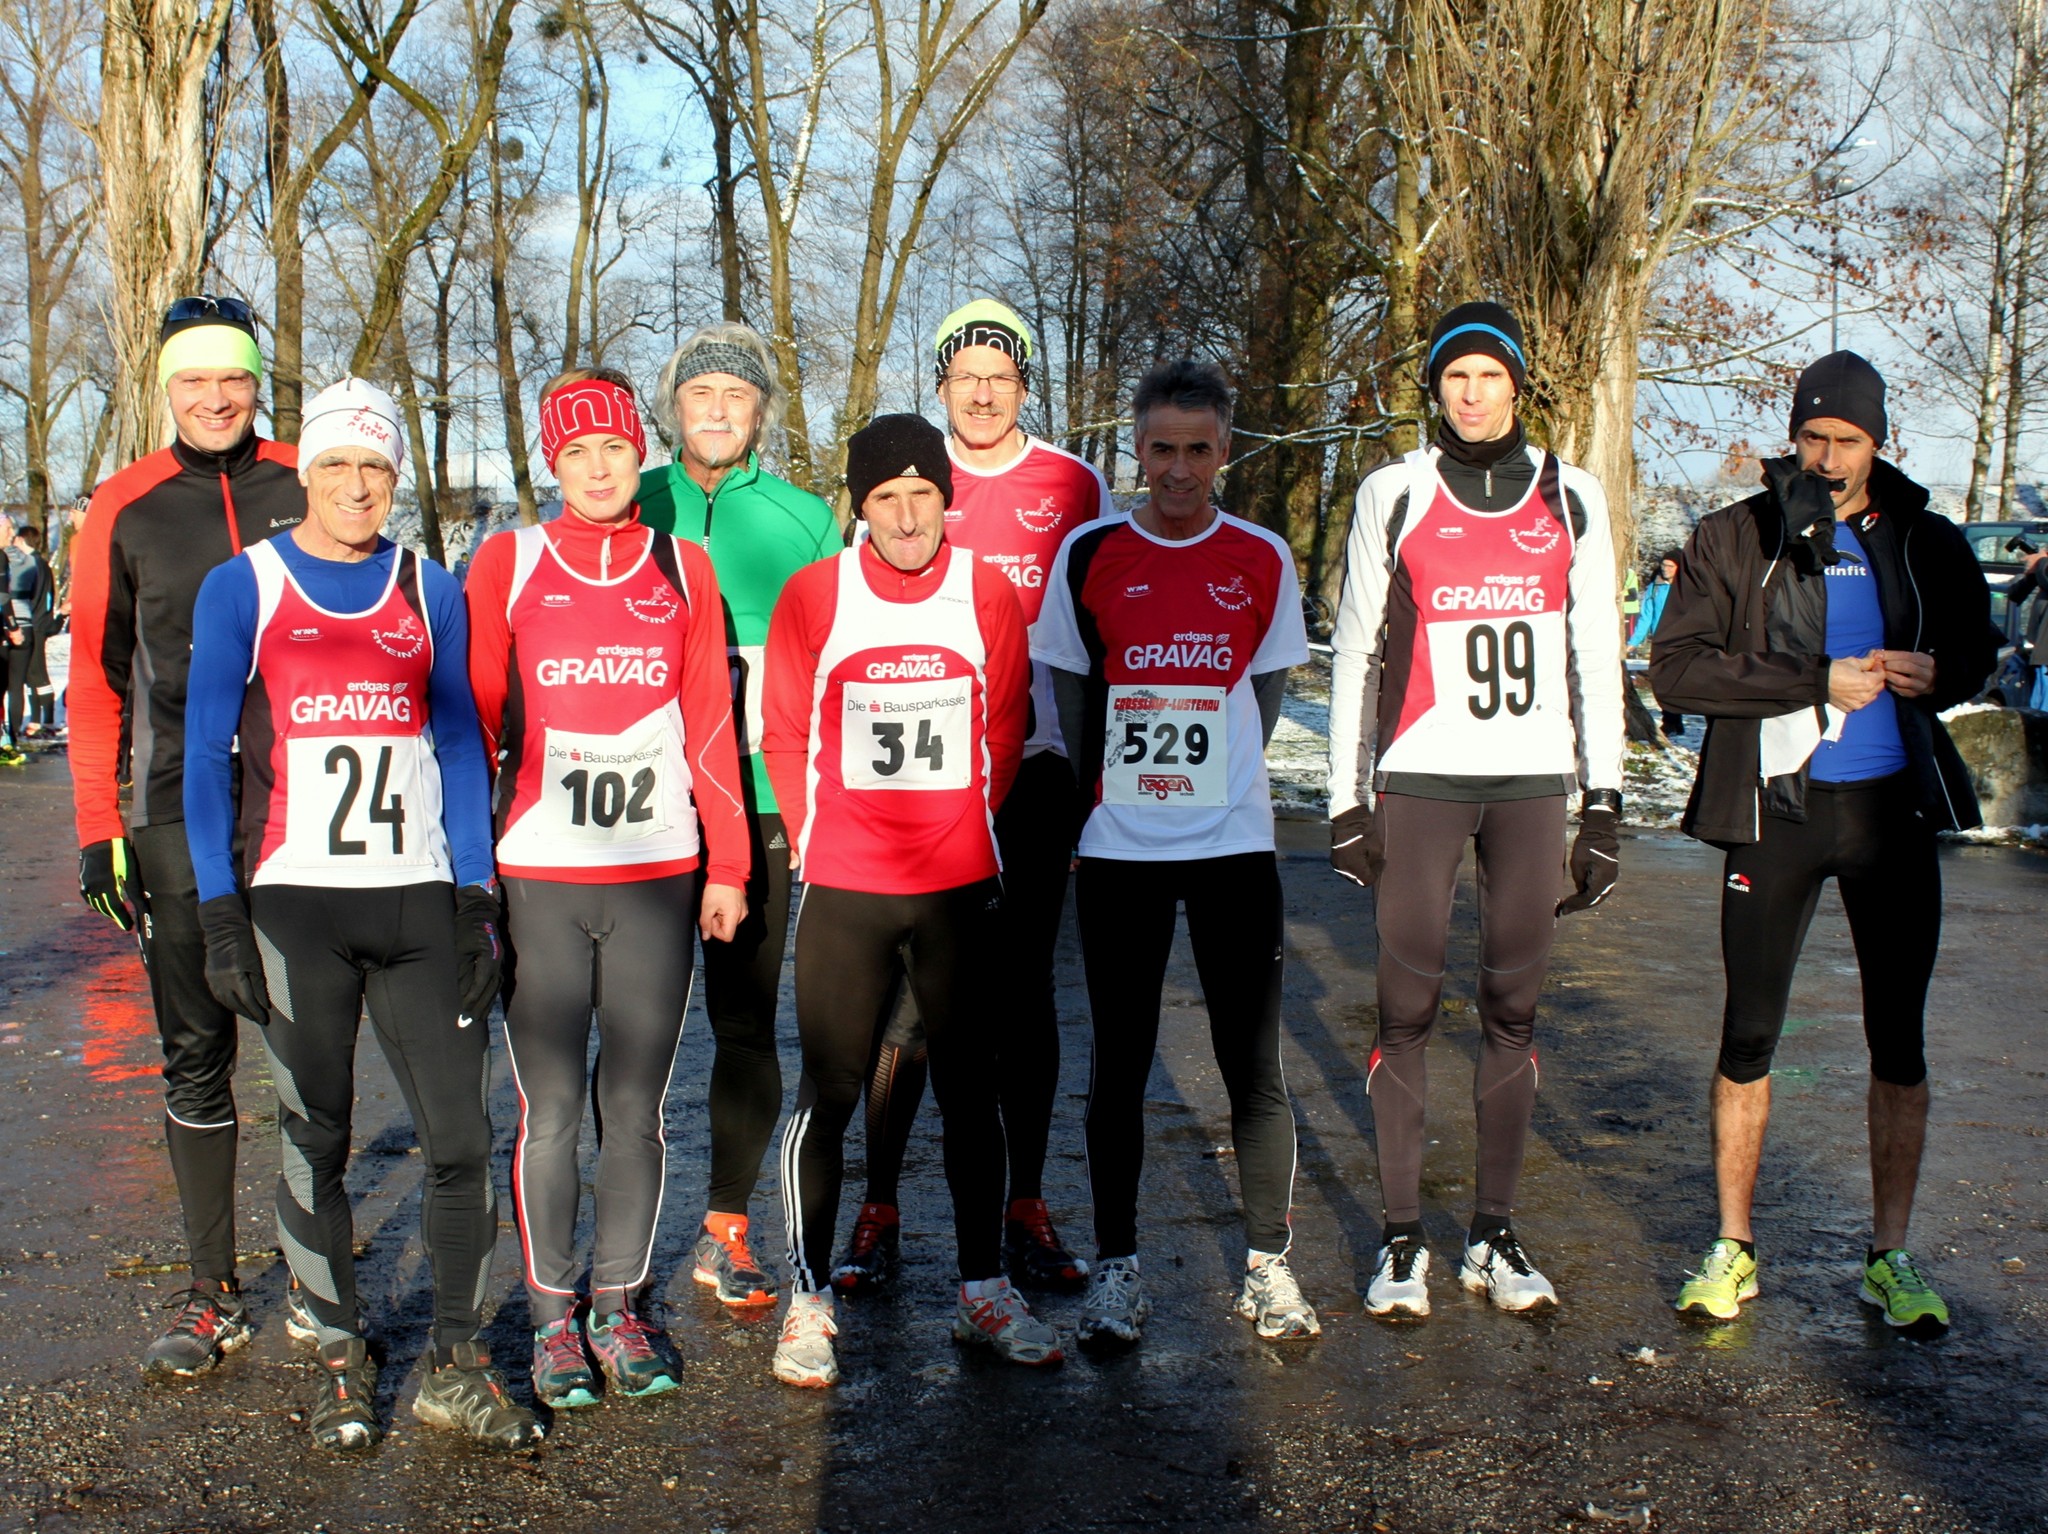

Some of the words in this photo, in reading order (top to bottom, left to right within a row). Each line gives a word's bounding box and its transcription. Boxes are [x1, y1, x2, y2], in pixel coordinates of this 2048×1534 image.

[1508, 528, 1560, 555] RHEINTAL
[982, 553, 1021, 565] erdgas
[1483, 573, 1525, 587] erdgas
[624, 597, 679, 624] RHEINTAL
[634, 599, 672, 607] MILA
[1431, 586, 1546, 612] GRAVAG
[371, 629, 425, 659] RHEINTAL
[382, 631, 417, 641] MILA
[1173, 631, 1214, 644] erdgas
[596, 644, 644, 657] erdgas
[1124, 644, 1233, 672] GRAVAG
[536, 658, 669, 687] GRAVAG
[866, 661, 946, 680] GRAVAG
[1465, 620, 1536, 720] 99
[346, 680, 390, 694] erdgas
[290, 694, 411, 724] GRAVAG
[847, 699, 867, 712] Die
[883, 695, 967, 713] Bausparkasse
[548, 745, 568, 760] Die
[583, 746, 664, 766] Bausparkasse
[871, 718, 944, 776] 34
[1123, 722, 1209, 766] 529
[324, 744, 406, 856] 24
[560, 766, 656, 828] 102
[144, 912, 153, 939] dlo
